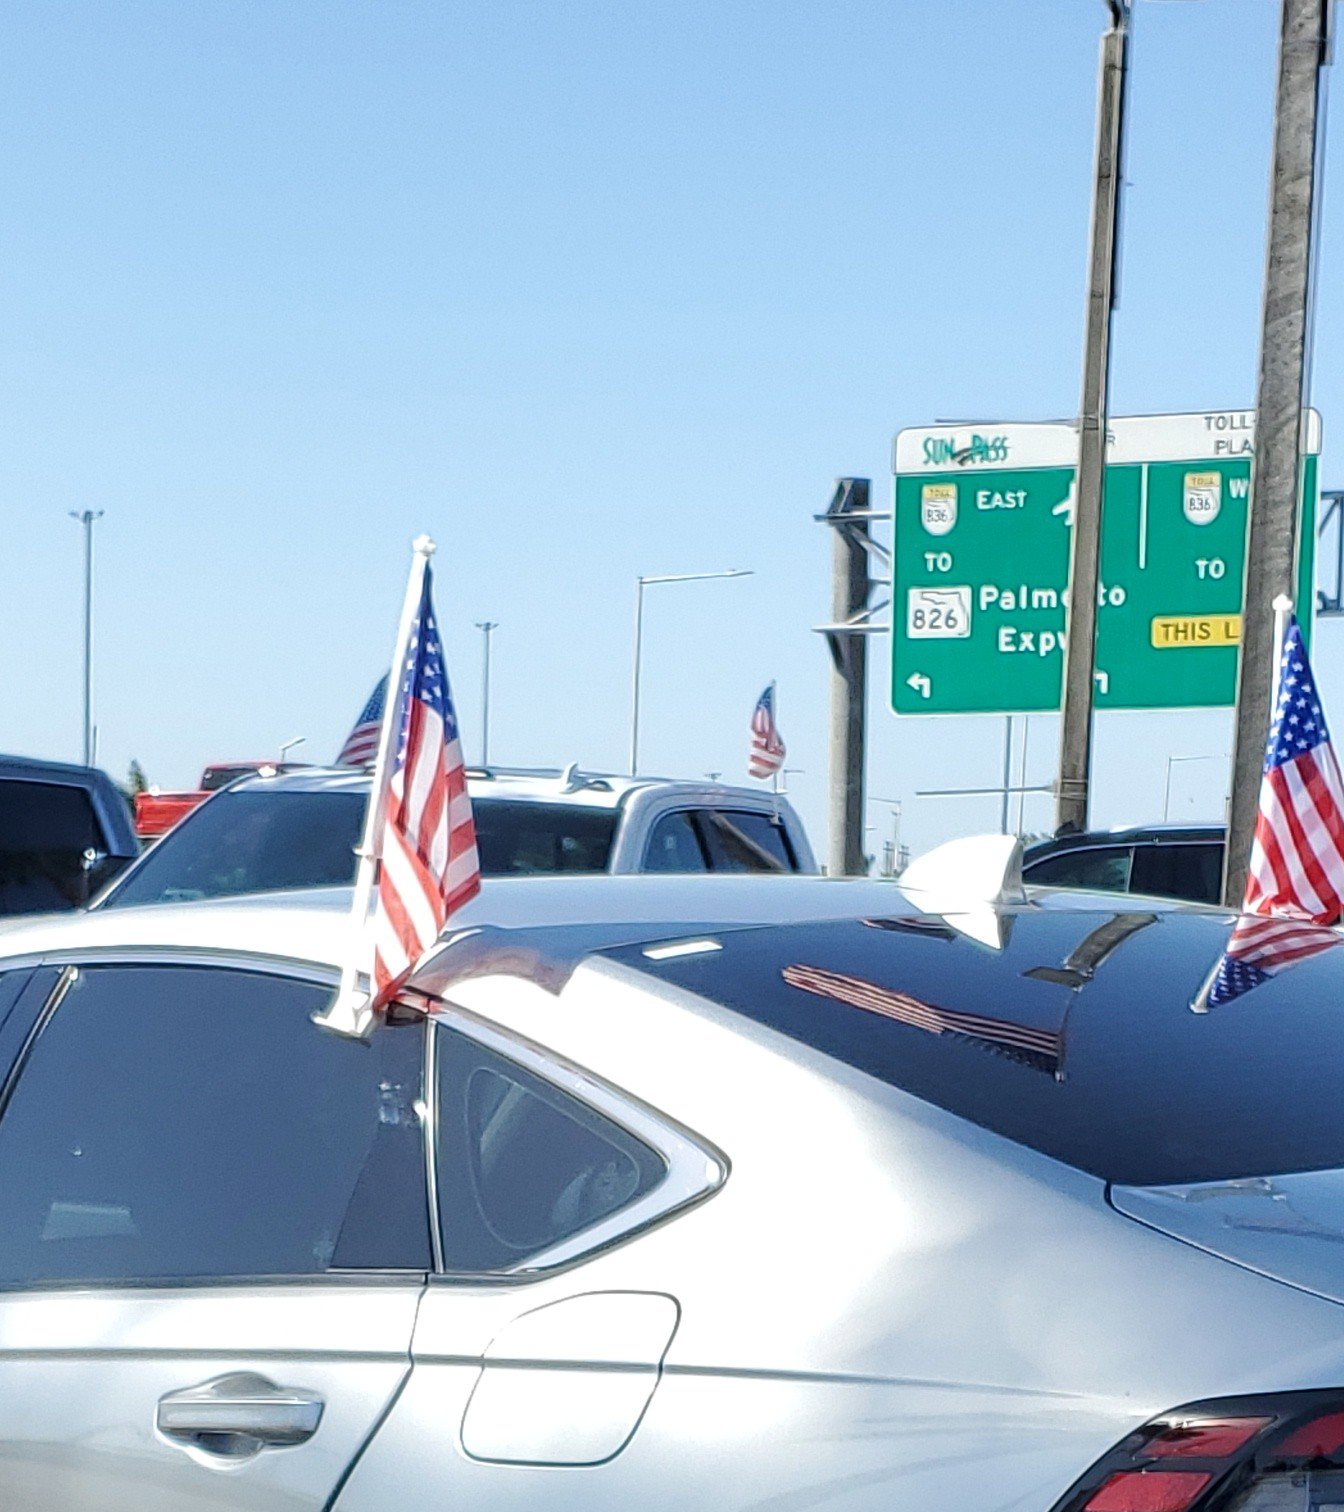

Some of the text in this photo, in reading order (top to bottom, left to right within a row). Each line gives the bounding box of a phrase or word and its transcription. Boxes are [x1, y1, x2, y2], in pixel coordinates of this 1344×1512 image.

[976, 490, 1028, 510] EAST
[924, 552, 953, 572] TO
[1195, 557, 1225, 579] TO
[913, 608, 958, 630] 826
[1160, 622, 1211, 641] THIS
